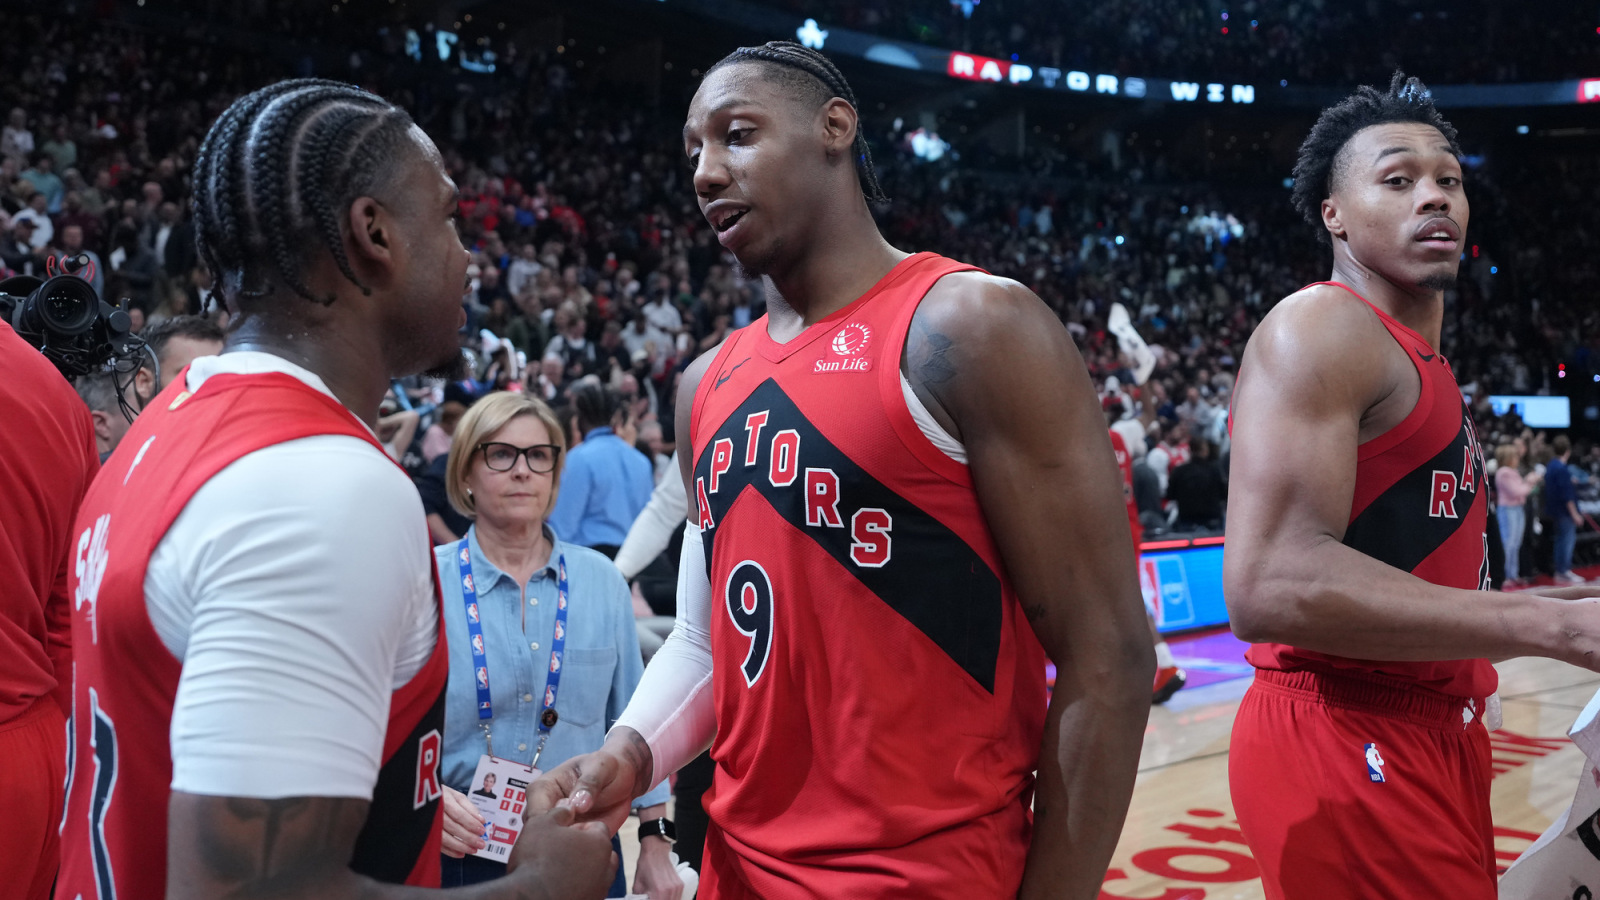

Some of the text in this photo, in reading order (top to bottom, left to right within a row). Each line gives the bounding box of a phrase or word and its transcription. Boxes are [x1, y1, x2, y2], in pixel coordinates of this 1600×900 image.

[953, 54, 1255, 104] RAPTORS WIN
[814, 357, 868, 372] Sun Life
[697, 410, 893, 568] APTORS
[725, 560, 774, 689] 9
